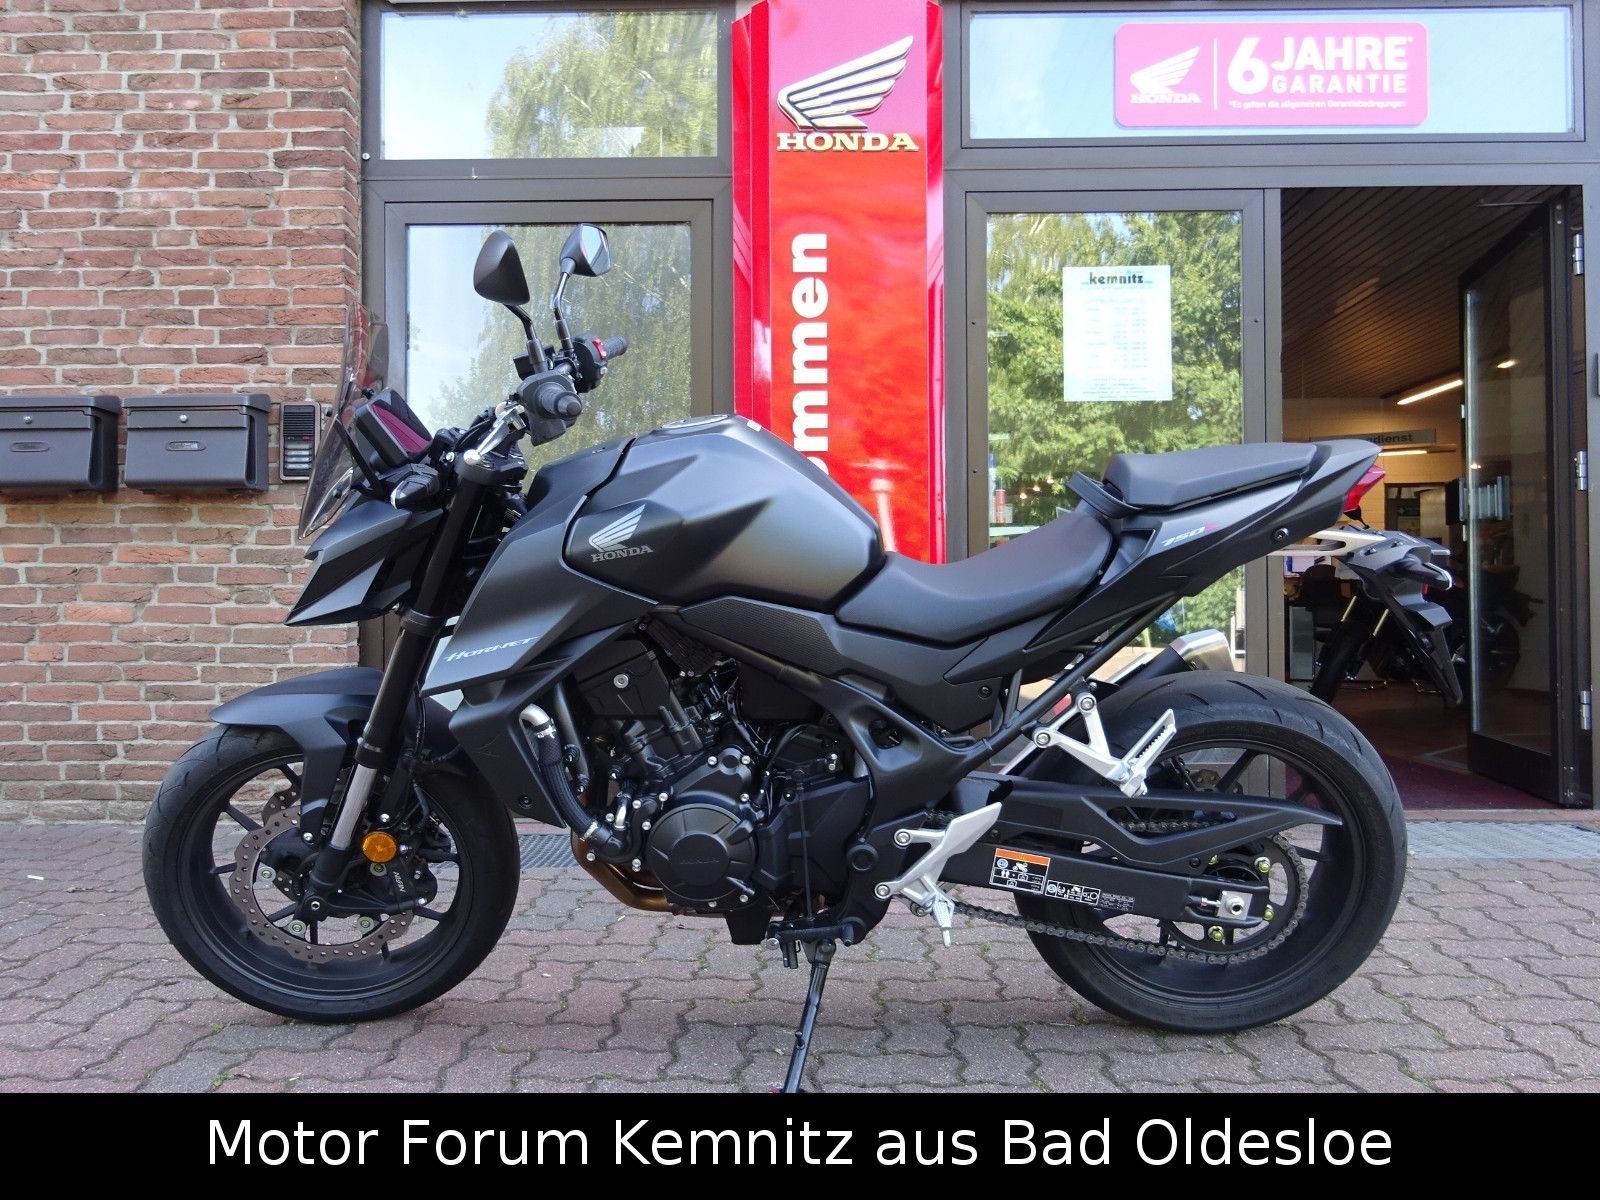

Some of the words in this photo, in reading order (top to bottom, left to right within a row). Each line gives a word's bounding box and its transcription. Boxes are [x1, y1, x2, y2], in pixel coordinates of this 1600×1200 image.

[1227, 37, 1269, 94] 6
[1271, 74, 1408, 94] GARANTIE
[1130, 92, 1201, 104] HONDA
[776, 131, 919, 152] HONDA
[1089, 271, 1144, 285] kemnitz
[591, 544, 654, 564] HONDA
